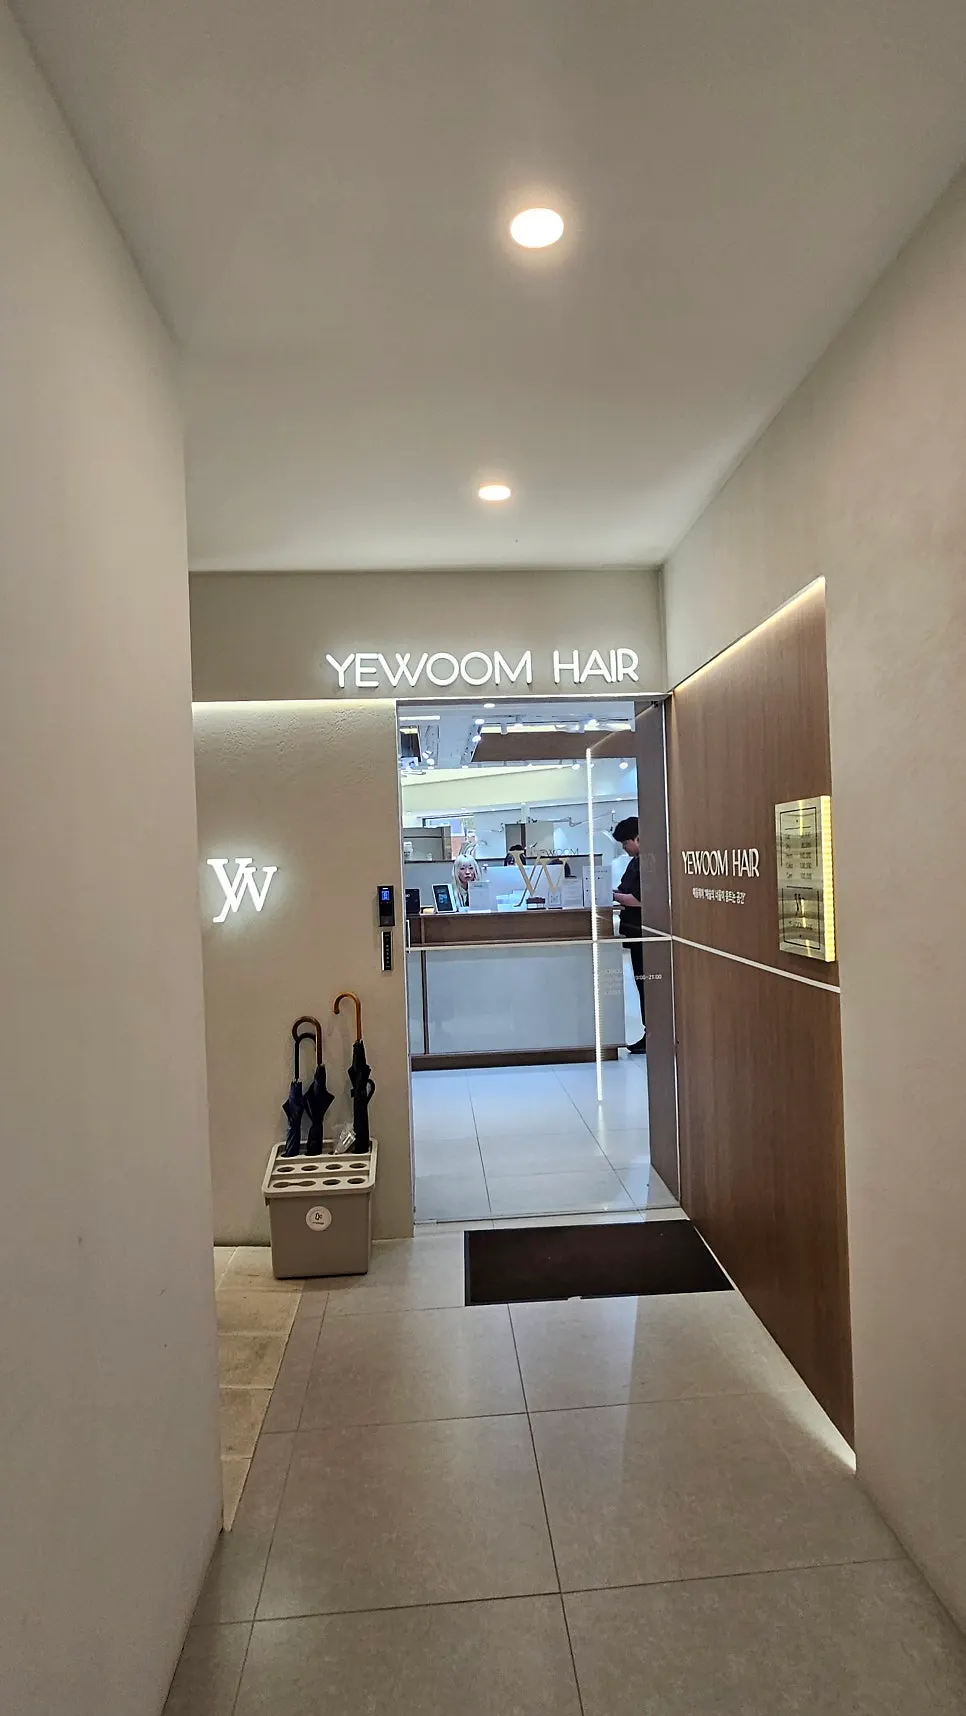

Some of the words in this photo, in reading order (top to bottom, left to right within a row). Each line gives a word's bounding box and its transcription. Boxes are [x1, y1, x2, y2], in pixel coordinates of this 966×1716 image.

[325, 650, 532, 688] YEWOOM
[553, 648, 640, 685] HAIR
[682, 849, 729, 876] YEWOOM
[732, 848, 760, 877] HAIR
